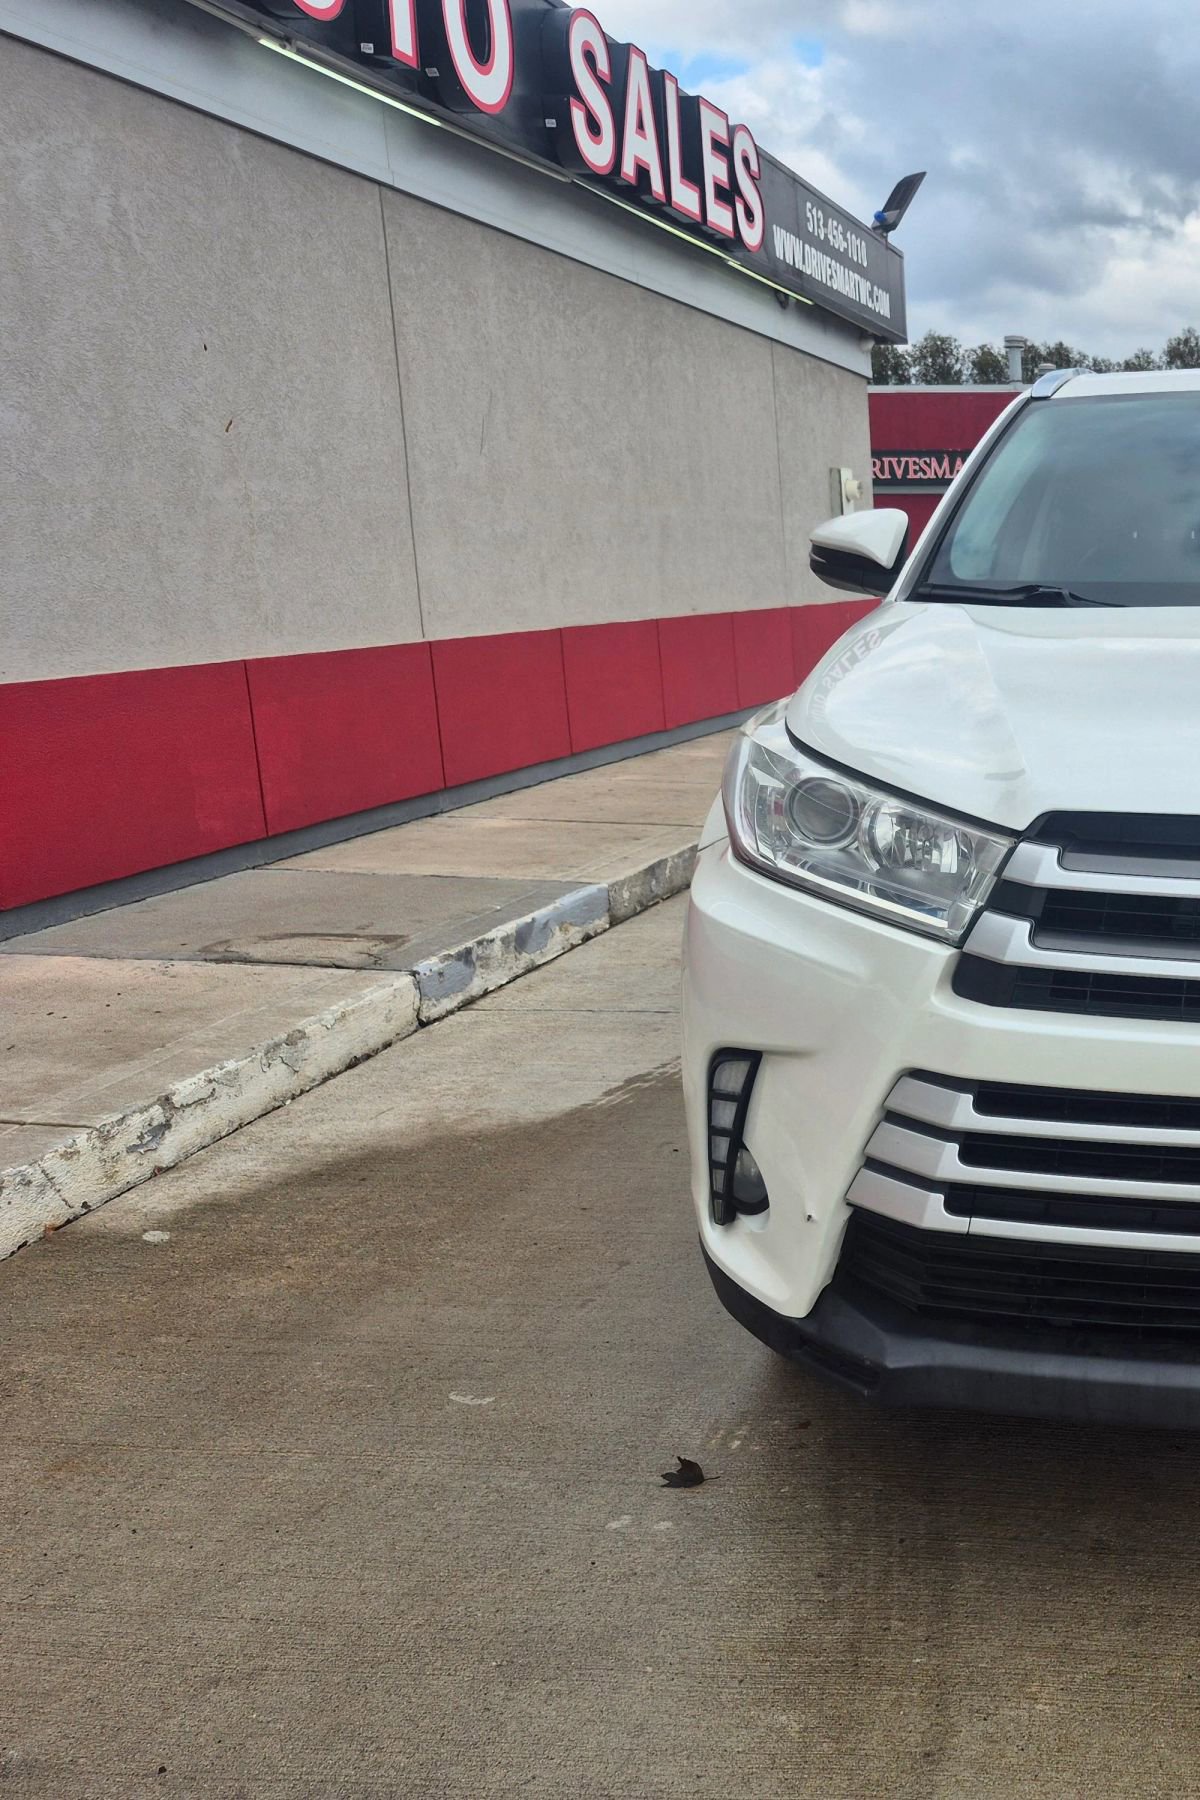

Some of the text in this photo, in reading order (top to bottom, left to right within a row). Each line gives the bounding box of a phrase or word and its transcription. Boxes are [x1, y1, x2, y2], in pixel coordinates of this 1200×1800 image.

[569, 7, 765, 253] SALES
[773, 224, 891, 319] WWW.DRIVESMARTWC.COM
[806, 201, 868, 268] 513-456-1010
